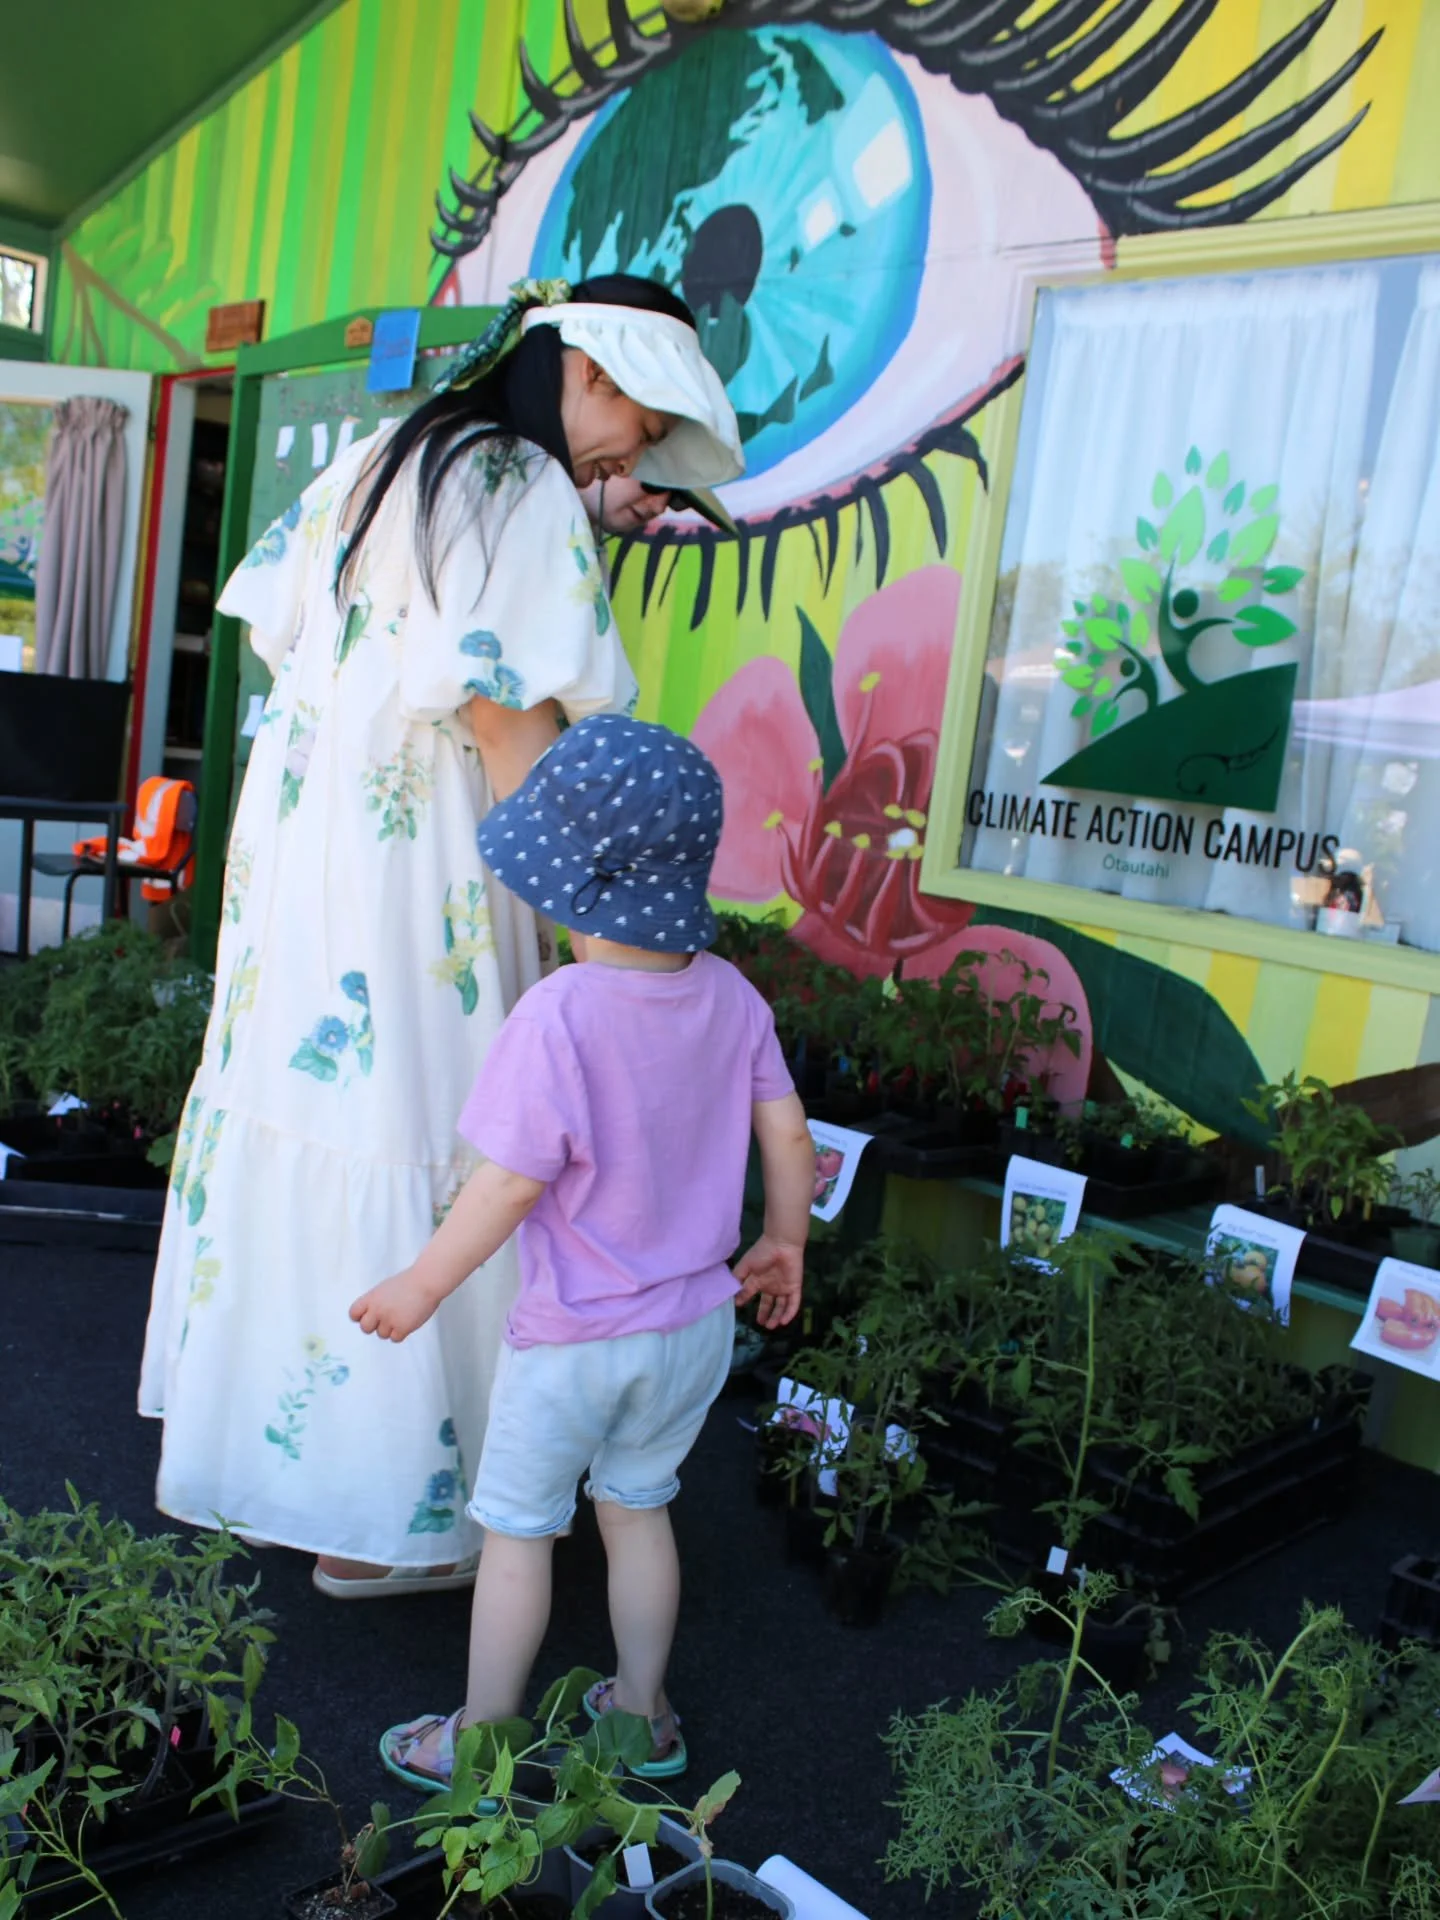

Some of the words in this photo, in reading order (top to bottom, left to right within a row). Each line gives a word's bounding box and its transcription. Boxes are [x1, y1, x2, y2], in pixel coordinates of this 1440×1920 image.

[968, 789, 1080, 840] CLIMATE
[1086, 804, 1195, 855] ACTION
[1204, 819, 1340, 875] CAMPUS
